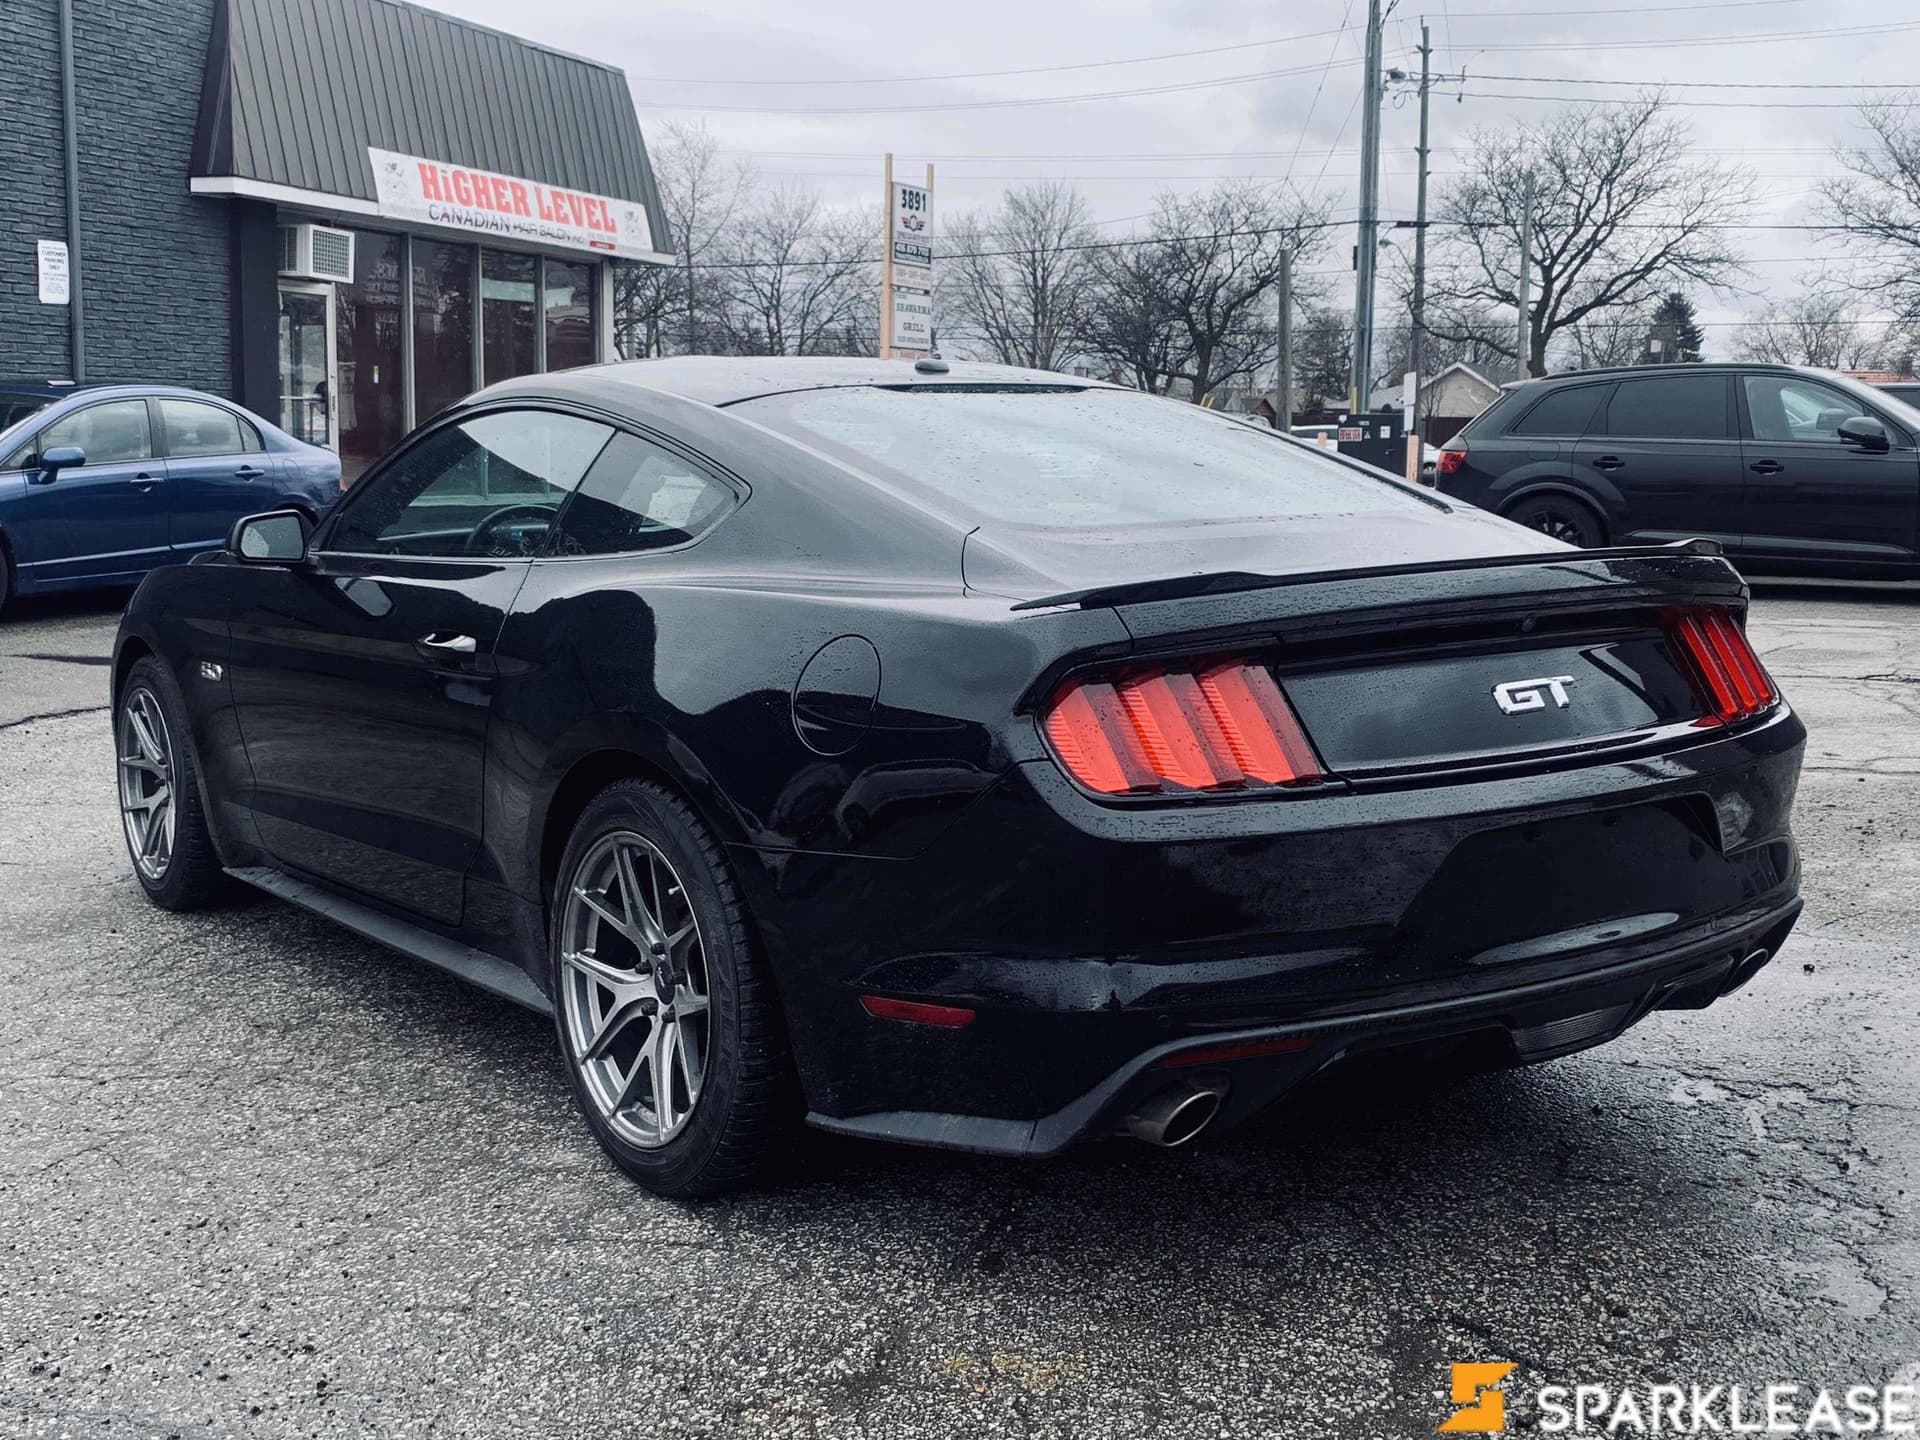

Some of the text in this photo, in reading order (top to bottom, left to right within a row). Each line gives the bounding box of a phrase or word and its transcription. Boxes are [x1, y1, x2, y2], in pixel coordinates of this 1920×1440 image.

[428, 203, 512, 233] CANADIAN
[534, 186, 618, 233] LEVEL
[901, 188, 926, 213] 3891
[1491, 675, 1575, 716] GT
